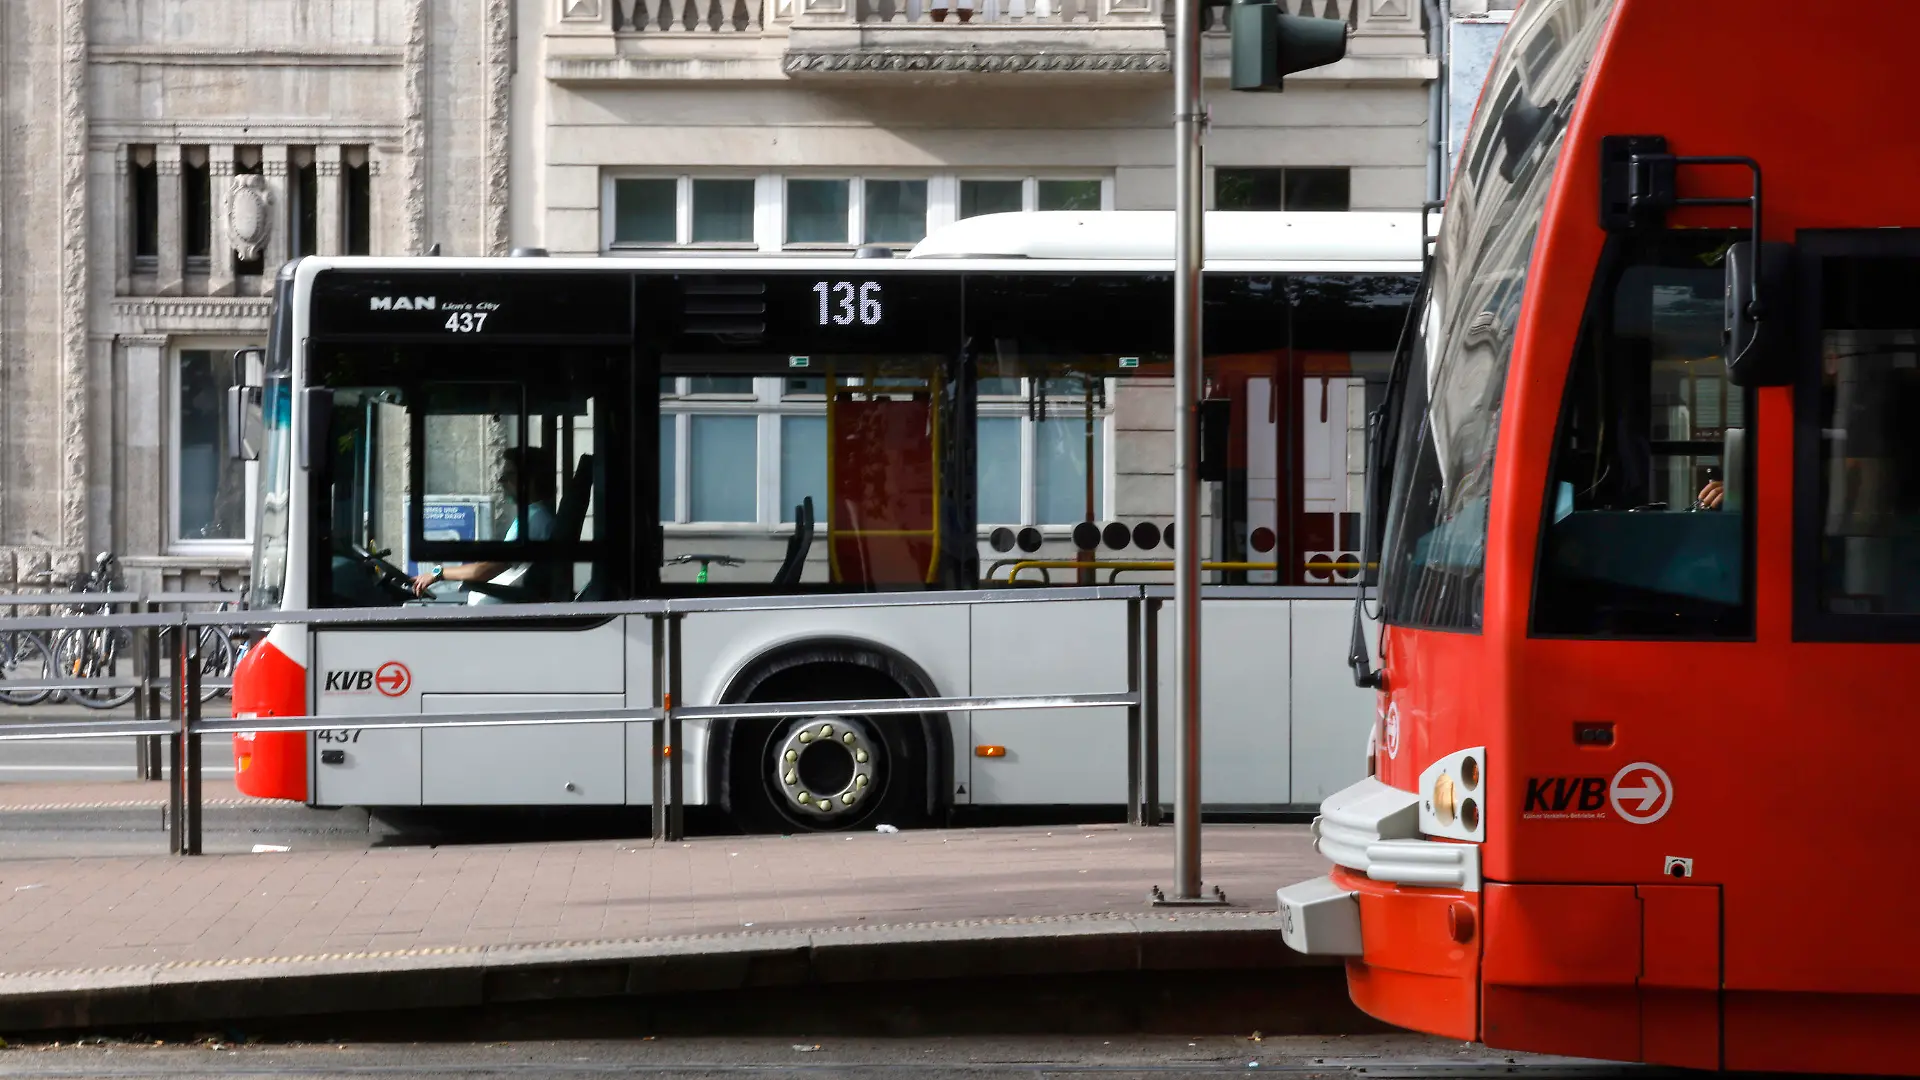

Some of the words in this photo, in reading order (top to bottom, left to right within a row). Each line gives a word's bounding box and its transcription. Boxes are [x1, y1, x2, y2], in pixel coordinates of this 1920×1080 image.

[370, 296, 435, 311] MAN
[441, 302, 473, 311] Lion's
[475, 302, 501, 312] City
[812, 281, 882, 325] 136
[445, 312, 488, 333] 437
[325, 671, 373, 690] KVB
[1524, 778, 1606, 811] KVB
